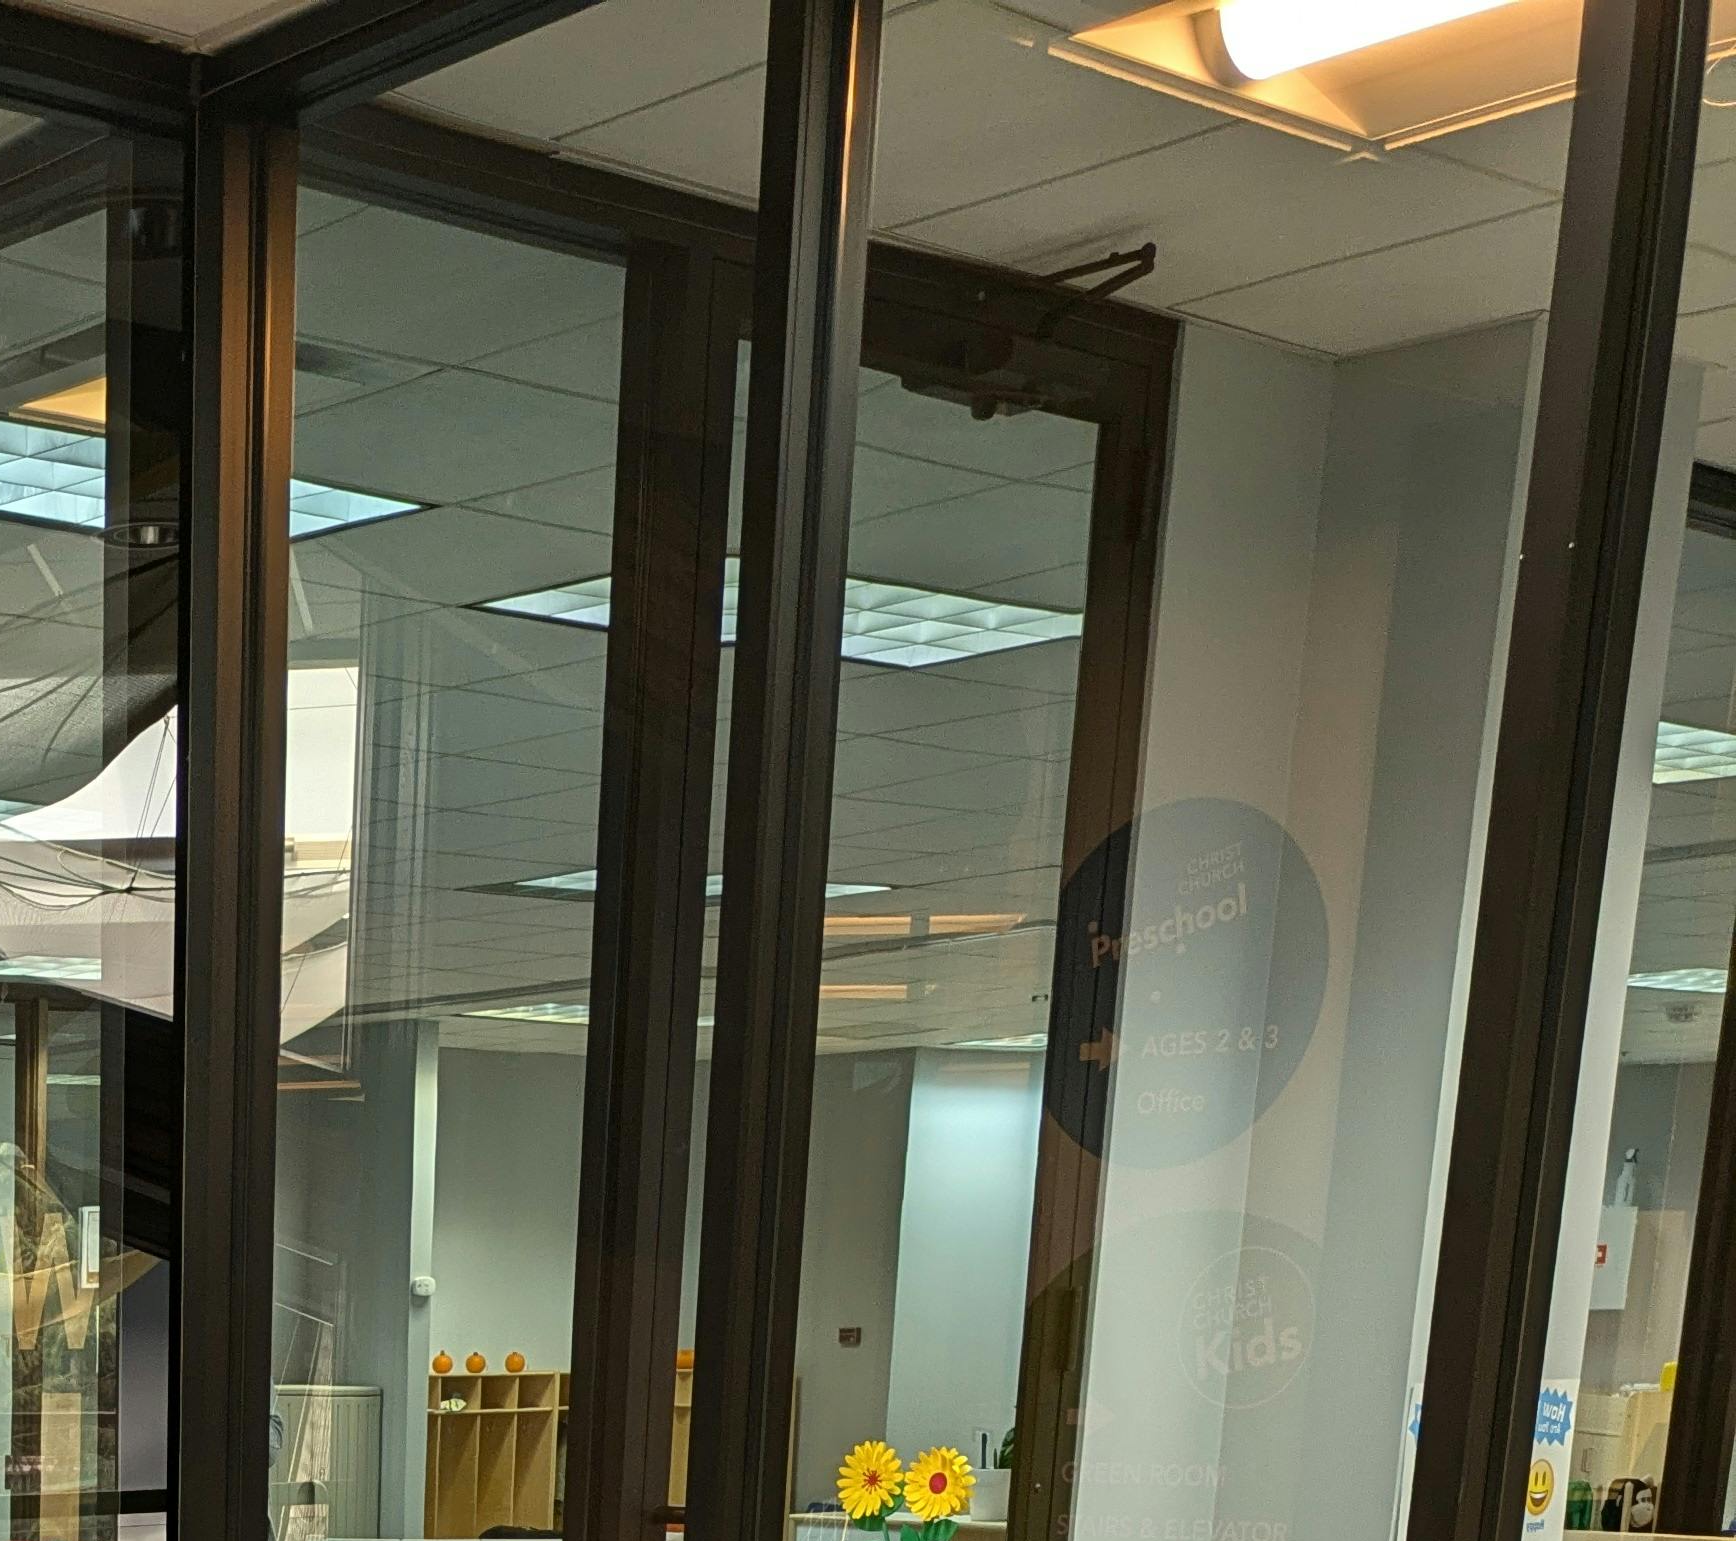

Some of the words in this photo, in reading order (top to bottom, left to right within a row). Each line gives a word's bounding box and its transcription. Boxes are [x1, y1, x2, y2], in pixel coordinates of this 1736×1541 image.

[1091, 882, 1248, 969] Preschool
[1143, 1031, 1208, 1059] AGES
[1216, 1029, 1232, 1051] 2
[1238, 1026, 1256, 1050] &
[1265, 1024, 1280, 1049] 3
[1136, 1088, 1206, 1114] Office
[1196, 1316, 1304, 1381] Kids
